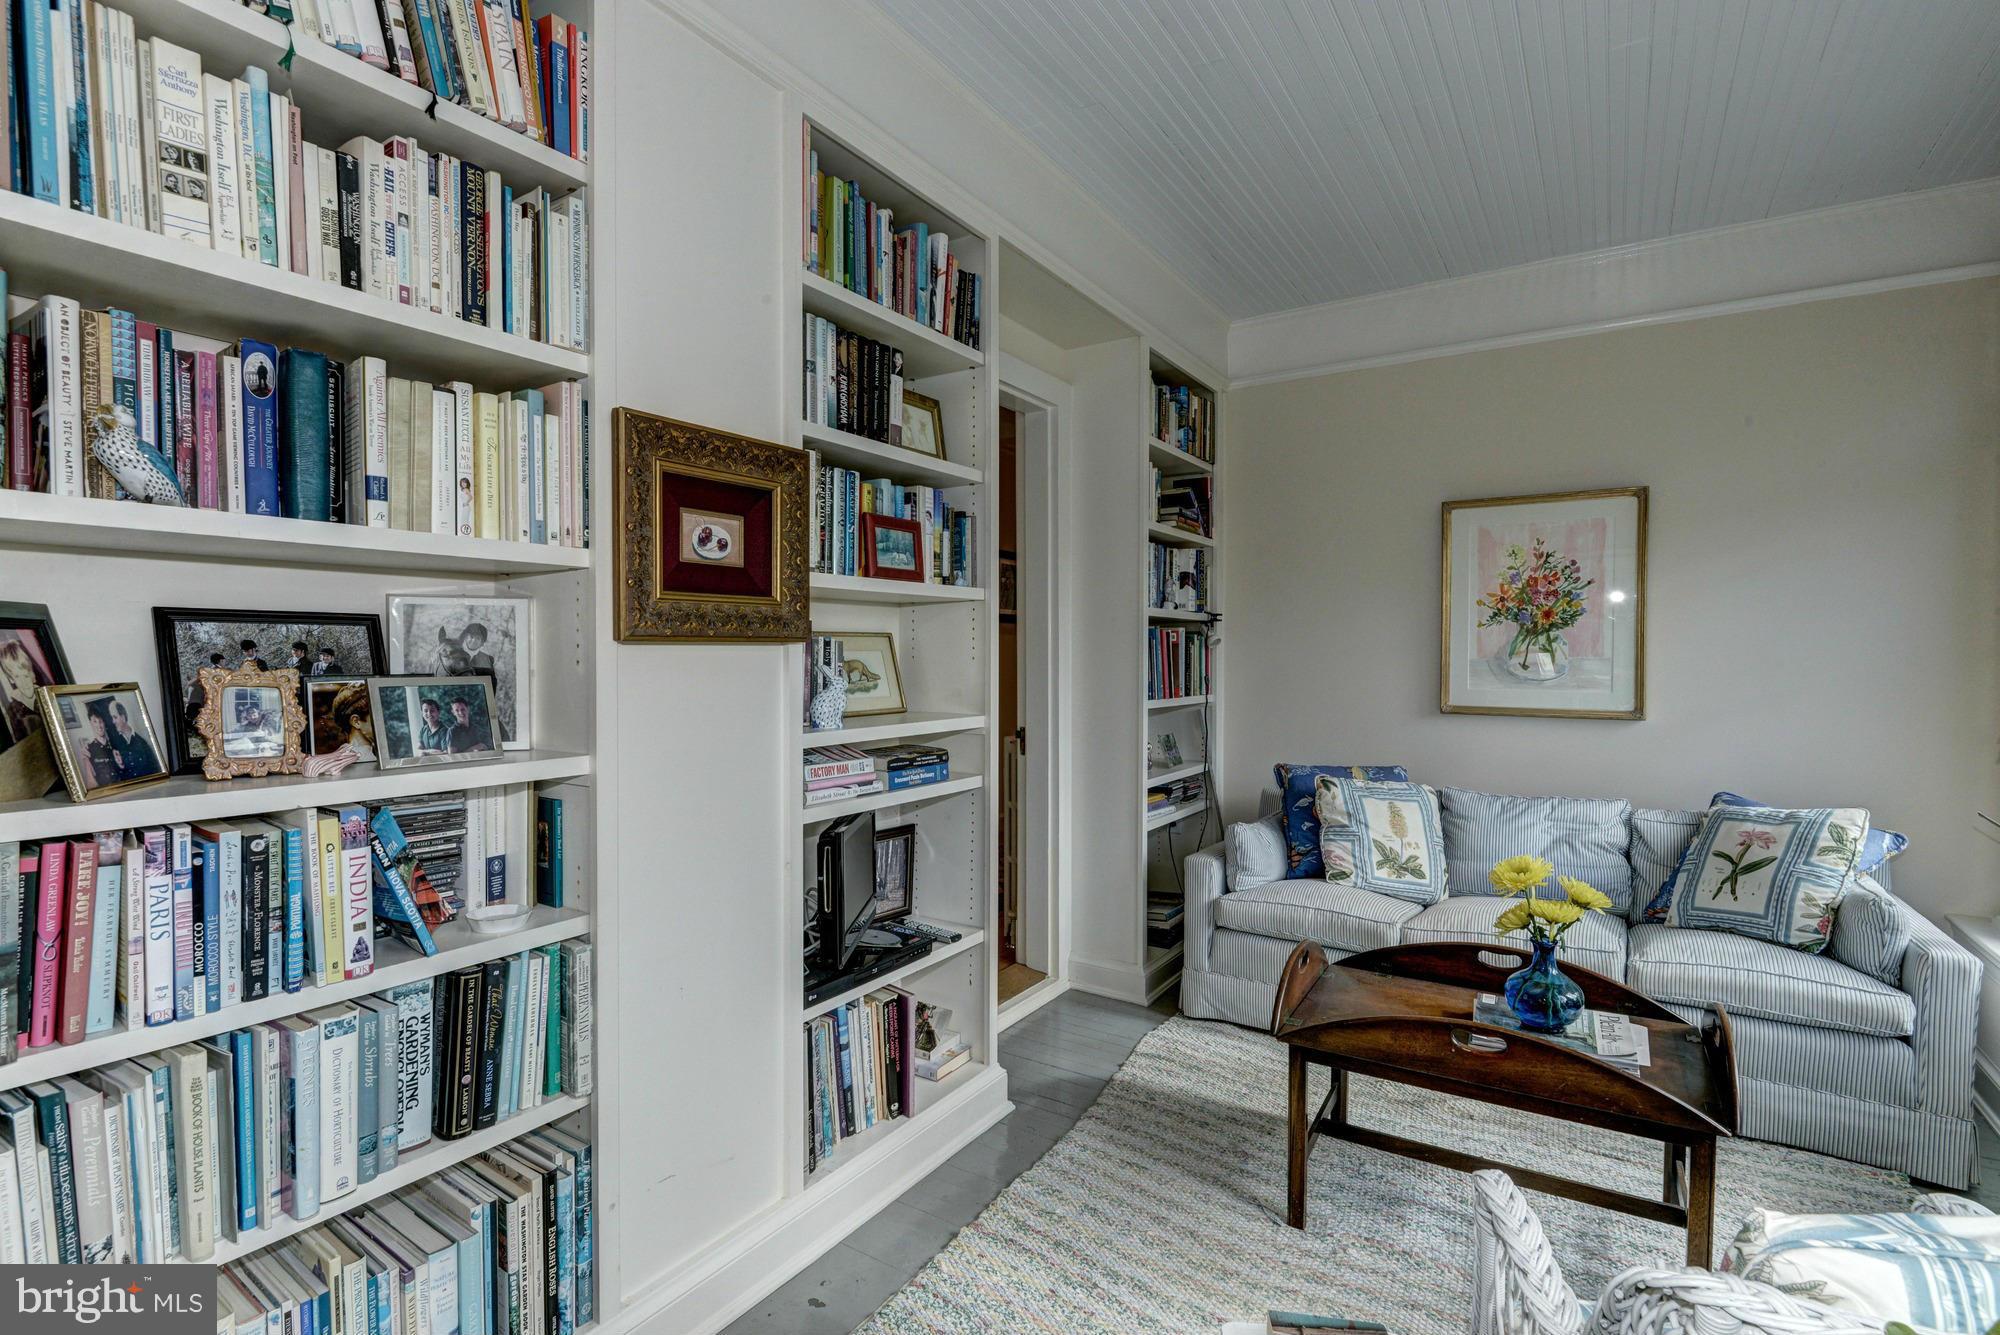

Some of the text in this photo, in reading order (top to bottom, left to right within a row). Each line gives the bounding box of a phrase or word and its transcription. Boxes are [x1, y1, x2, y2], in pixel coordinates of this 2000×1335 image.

[461, 29, 475, 71] ISLANDS
[492, 11, 515, 73] SPAIN
[160, 79, 197, 98] Anthony
[167, 64, 187, 78] Carl
[518, 48, 531, 98] FRANCISCO
[159, 121, 205, 147] LADIES
[163, 107, 199, 126] FIRST
[239, 91, 251, 142] Washington,
[213, 98, 232, 192] Washington Itself
[369, 162, 381, 245] Washington Itself
[384, 166, 395, 257] HAIL CHIEFS
[399, 166, 407, 206] ACCESS
[466, 166, 476, 213] MOUNT
[321, 207, 332, 246] GOES WAR
[331, 209, 340, 249] WASHINGTON
[352, 192, 361, 244] WASHINGTON
[431, 199, 441, 281] WASHINGTON, DC
[467, 216, 476, 270] VERNON
[475, 170, 485, 307] GEORGE WASHINGTON'S
[573, 209, 581, 290] MORNINGS HORSEBACK
[85, 320, 99, 376] NORWICH
[142, 343, 152, 398] TOM BROKAW
[163, 351, 171, 389] HORSEFOLK
[60, 303, 74, 484] AN OBJECT OF BEAUTY STEVE MARTIN
[182, 371, 192, 449] RELIABLE WIFE
[204, 410, 212, 428] Three
[247, 406, 256, 425] DAVID
[374, 370, 387, 463] Against All Enemies
[460, 388, 470, 443] SUSAN LUCCI
[840, 374, 848, 424] JOHN GRISHAM
[265, 418, 273, 471] GREATER JOURNEY
[825, 484, 833, 514] Grafton
[810, 763, 849, 779] FACTORY MAN
[372, 838, 391, 868] MOON
[46, 852, 60, 933] LINDA GREENLAW
[74, 849, 94, 926] TAKE JOY!
[150, 883, 171, 942] PARIS
[254, 872, 263, 951] MONSTER FLORENCE
[291, 893, 301, 930] PORTUGAL
[348, 855, 369, 920] INDIA
[388, 870, 423, 930] NOVA SCOTIA
[103, 880, 115, 1000] HER FEARFUL SYMMETRY
[131, 877, 140, 1001] Strong Caldwell
[194, 922, 204, 973] MOROCCO
[206, 914, 219, 986] MOROCCO STYLE
[41, 965, 52, 1009] SLIPKNOT
[469, 979, 476, 989] IN
[490, 984, 503, 1009] That
[151, 1010, 171, 1022] DK
[466, 1006, 474, 1035] GARDEN
[488, 1011, 502, 1051] Woman
[579, 982, 589, 1042] PERENNIALS
[384, 1040, 397, 1067] Trees
[405, 1016, 419, 1111] GARDENING
[420, 1011, 431, 1076] WYMAN'S
[464, 1047, 472, 1073] BEASTS
[465, 1036, 472, 1045] OF
[363, 1047, 377, 1087] Shrubs
[332, 1047, 343, 1167] DICTIONARY HORTICULTURE
[461, 1087, 469, 1115] LARSON
[484, 1083, 492, 1108] SEBBA
[110, 1114, 124, 1214] DICTIONARY PLANT NAMES
[190, 1092, 204, 1193] BOOK OF HOUSE PLANTS
[83, 1134, 106, 1207] Perennials
[582, 1178, 591, 1257] Native Plant Primer
[508, 1210, 520, 1307] rejuvenating garden
[549, 1226, 557, 1296] ENGLISH ROSES
[353, 1270, 364, 1330] THE PRINCIPLES
[368, 1287, 377, 1326] THE FLOWER
[408, 1297, 417, 1319] WILD
[419, 1278, 429, 1329] Wildflowers
